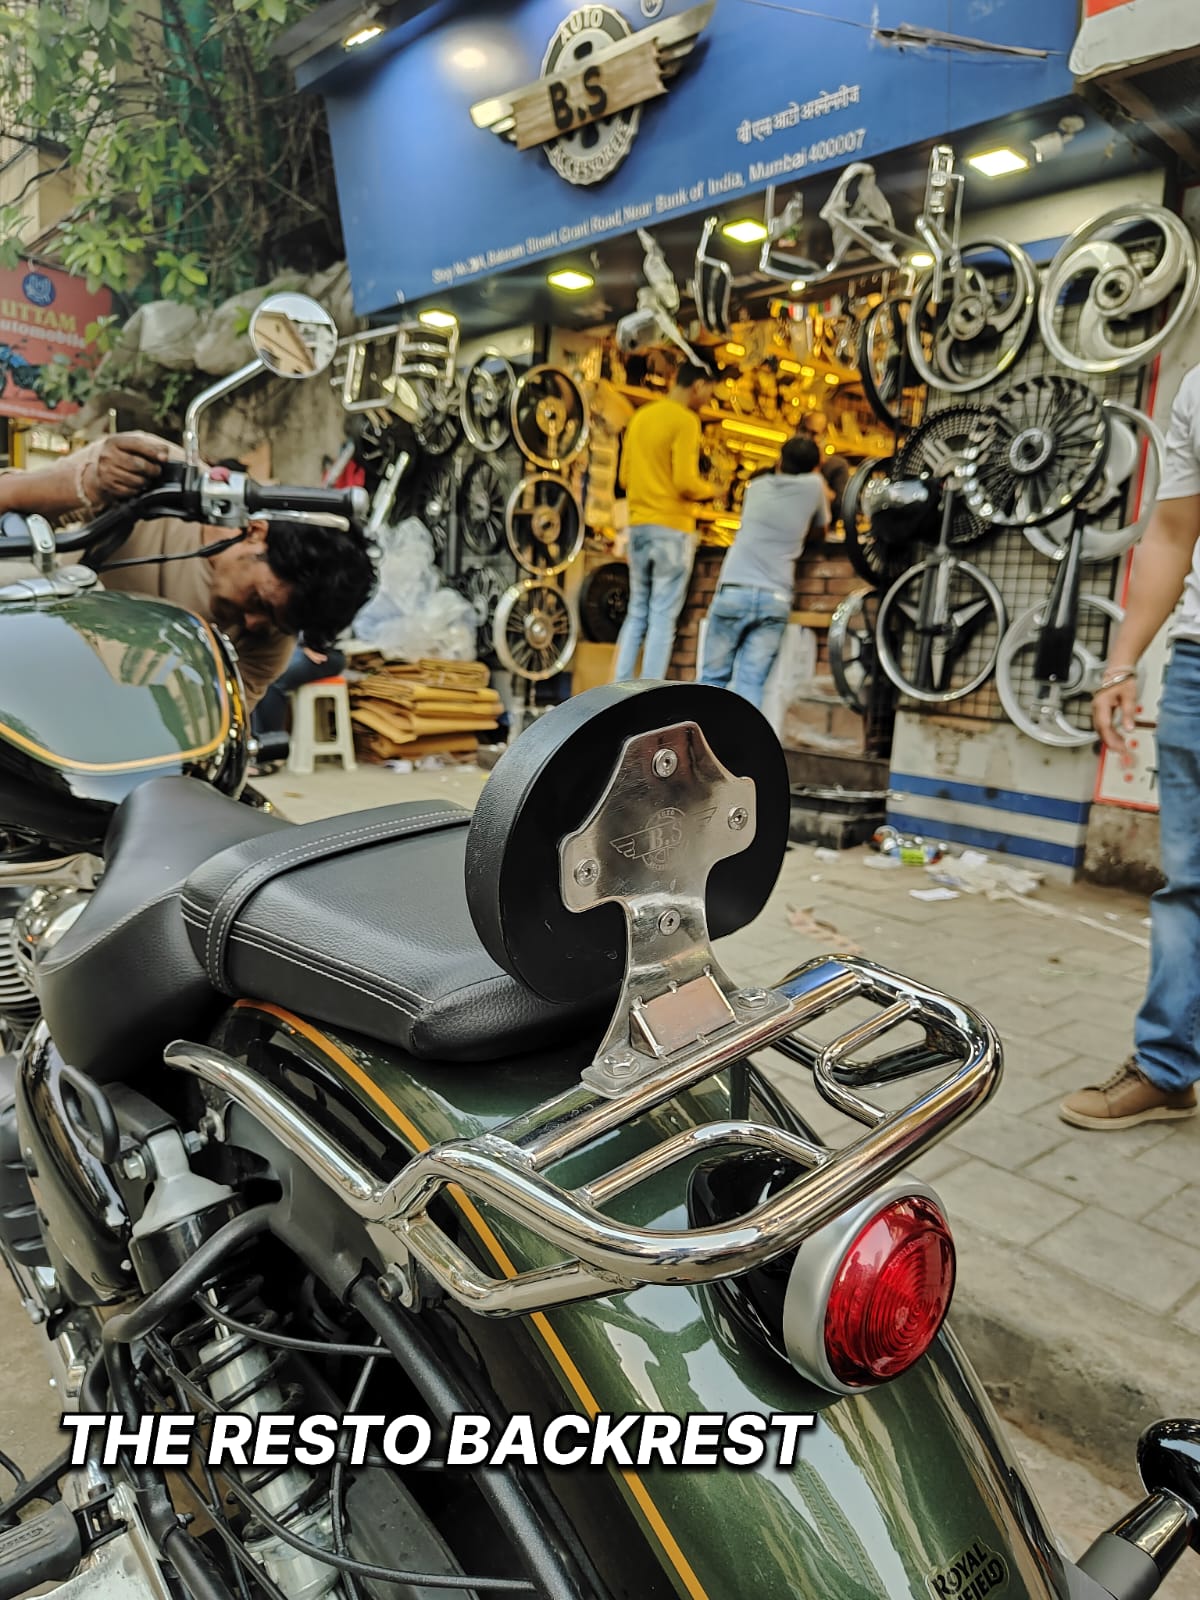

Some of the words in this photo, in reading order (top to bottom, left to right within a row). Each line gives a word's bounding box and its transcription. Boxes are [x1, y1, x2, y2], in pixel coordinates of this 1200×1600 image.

[560, 11, 603, 45] AUTO
[549, 65, 608, 130] B.S
[655, 189, 689, 214] Bank
[689, 181, 704, 202] of
[749, 150, 807, 183] Mumbai
[808, 128, 867, 163] 400007
[1, 299, 77, 333] UTTAM
[931, 1542, 988, 1600] ROYAL
